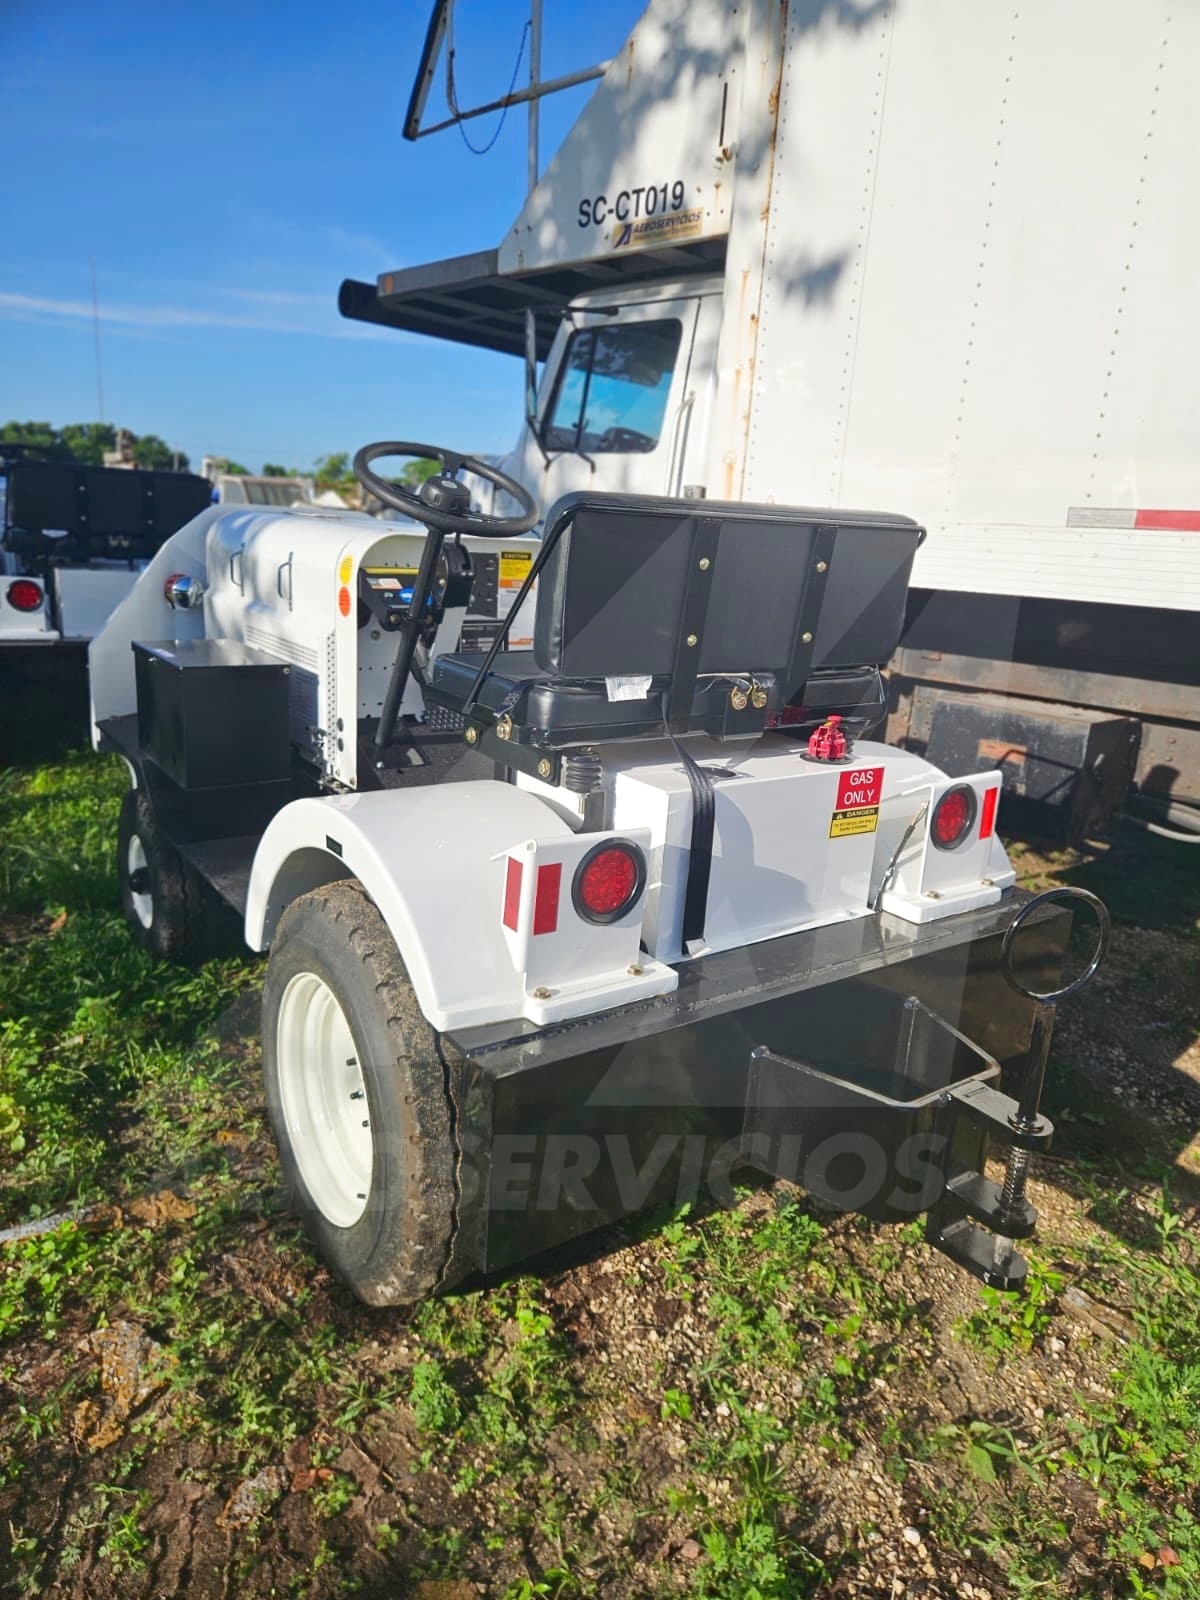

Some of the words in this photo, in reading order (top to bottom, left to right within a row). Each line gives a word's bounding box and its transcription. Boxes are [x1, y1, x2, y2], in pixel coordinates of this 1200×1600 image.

[578, 180, 684, 228] SC-CT019
[850, 770, 874, 786] GAS
[843, 789, 875, 805] ONLY
[846, 808, 875, 818] DANGER
